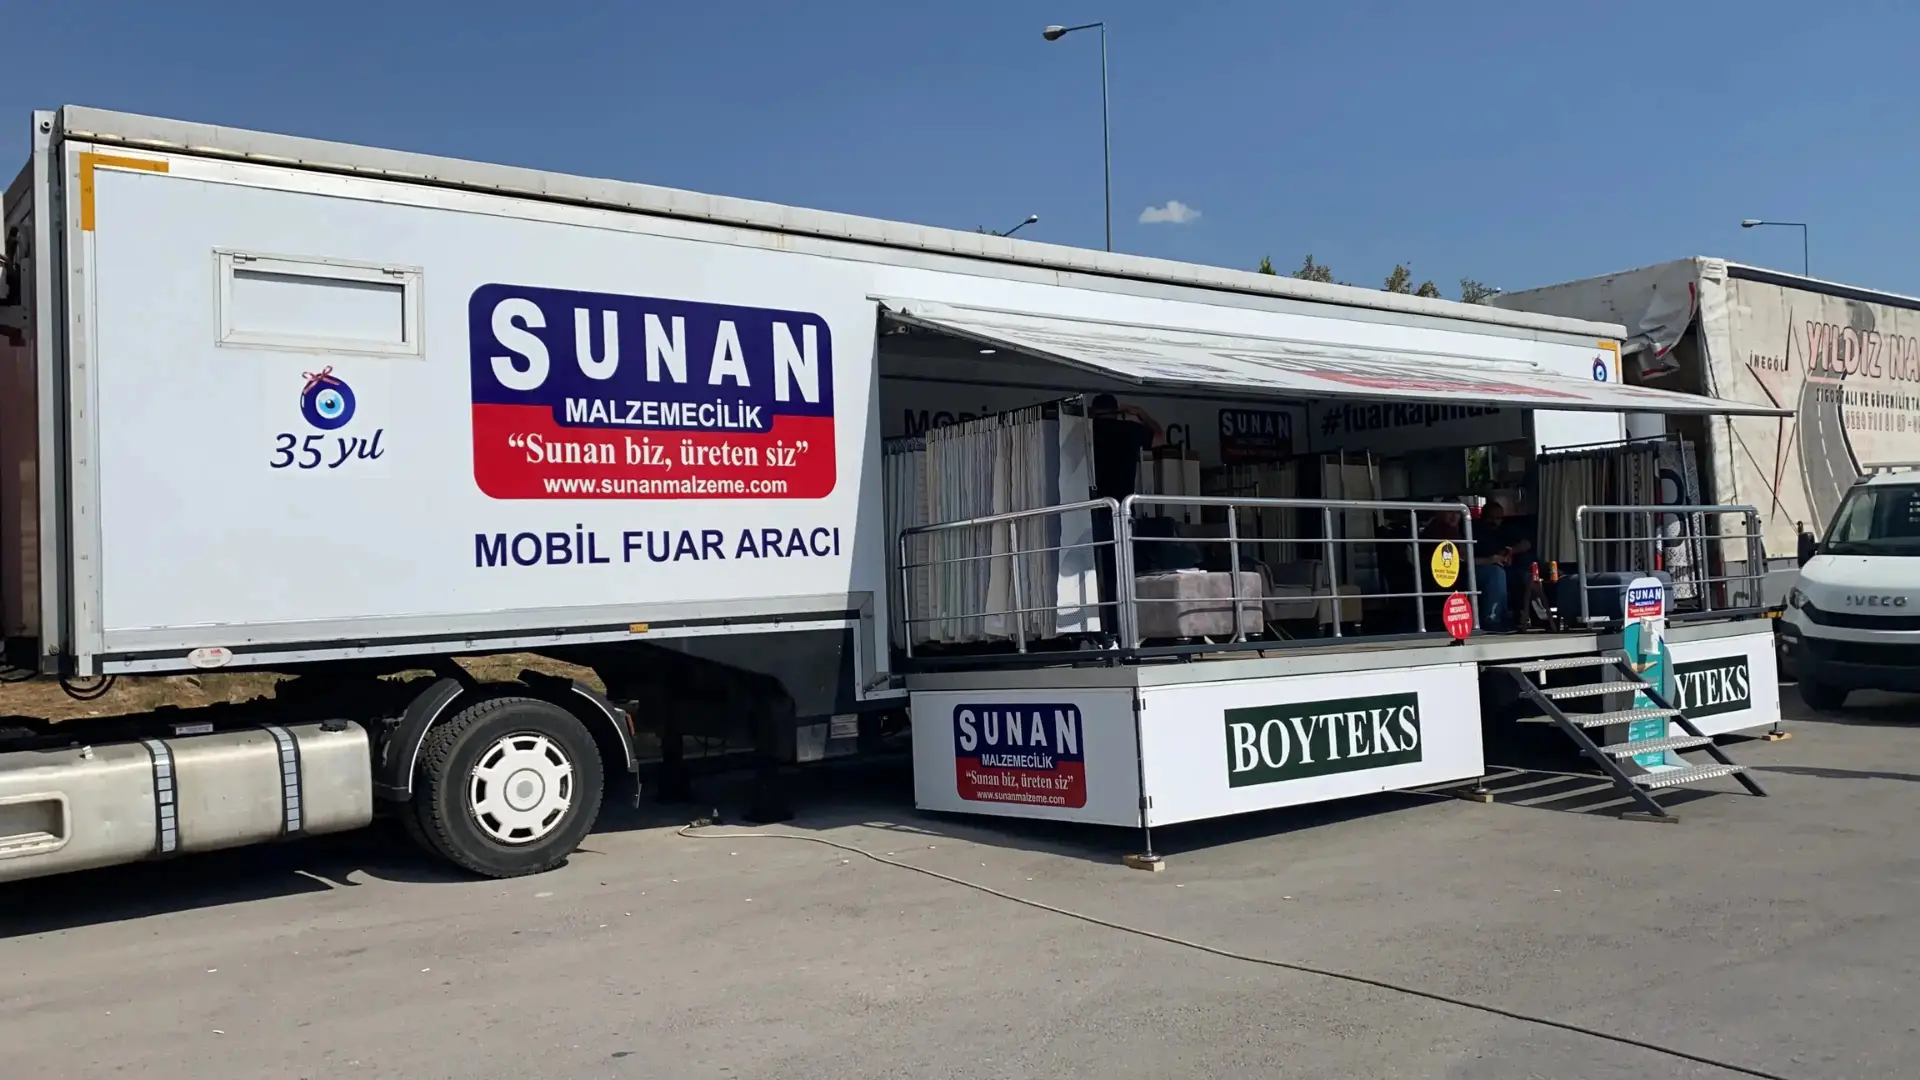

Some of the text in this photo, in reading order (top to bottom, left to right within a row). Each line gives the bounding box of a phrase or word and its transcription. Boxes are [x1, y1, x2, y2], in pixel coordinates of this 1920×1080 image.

[490, 297, 820, 404] SUNAN
[1806, 320, 1882, 378] YILDIZ
[564, 397, 763, 430] MALZEMECİLİK
[1221, 411, 1290, 440] SUNAN
[270, 428, 385, 470] 35 yıl
[508, 432, 808, 472] “Sunan biz, üreten siz”
[543, 476, 788, 495] www.sunanmalzeme.com
[474, 523, 841, 568] MOBİL FUAR ARACI
[1630, 588, 1662, 603] SUNAN
[1846, 595, 1907, 608] IVECO
[1674, 664, 1749, 710] YTEKS
[959, 709, 1078, 755] SUNAN
[1229, 704, 1419, 773] BOYTEKS
[981, 753, 1054, 768] MALZEMECİLİK
[976, 791, 1066, 805] www.sunanmalzeme.com
[1001, 772, 1019, 790] biz,
[1021, 773, 1052, 789] üreten
